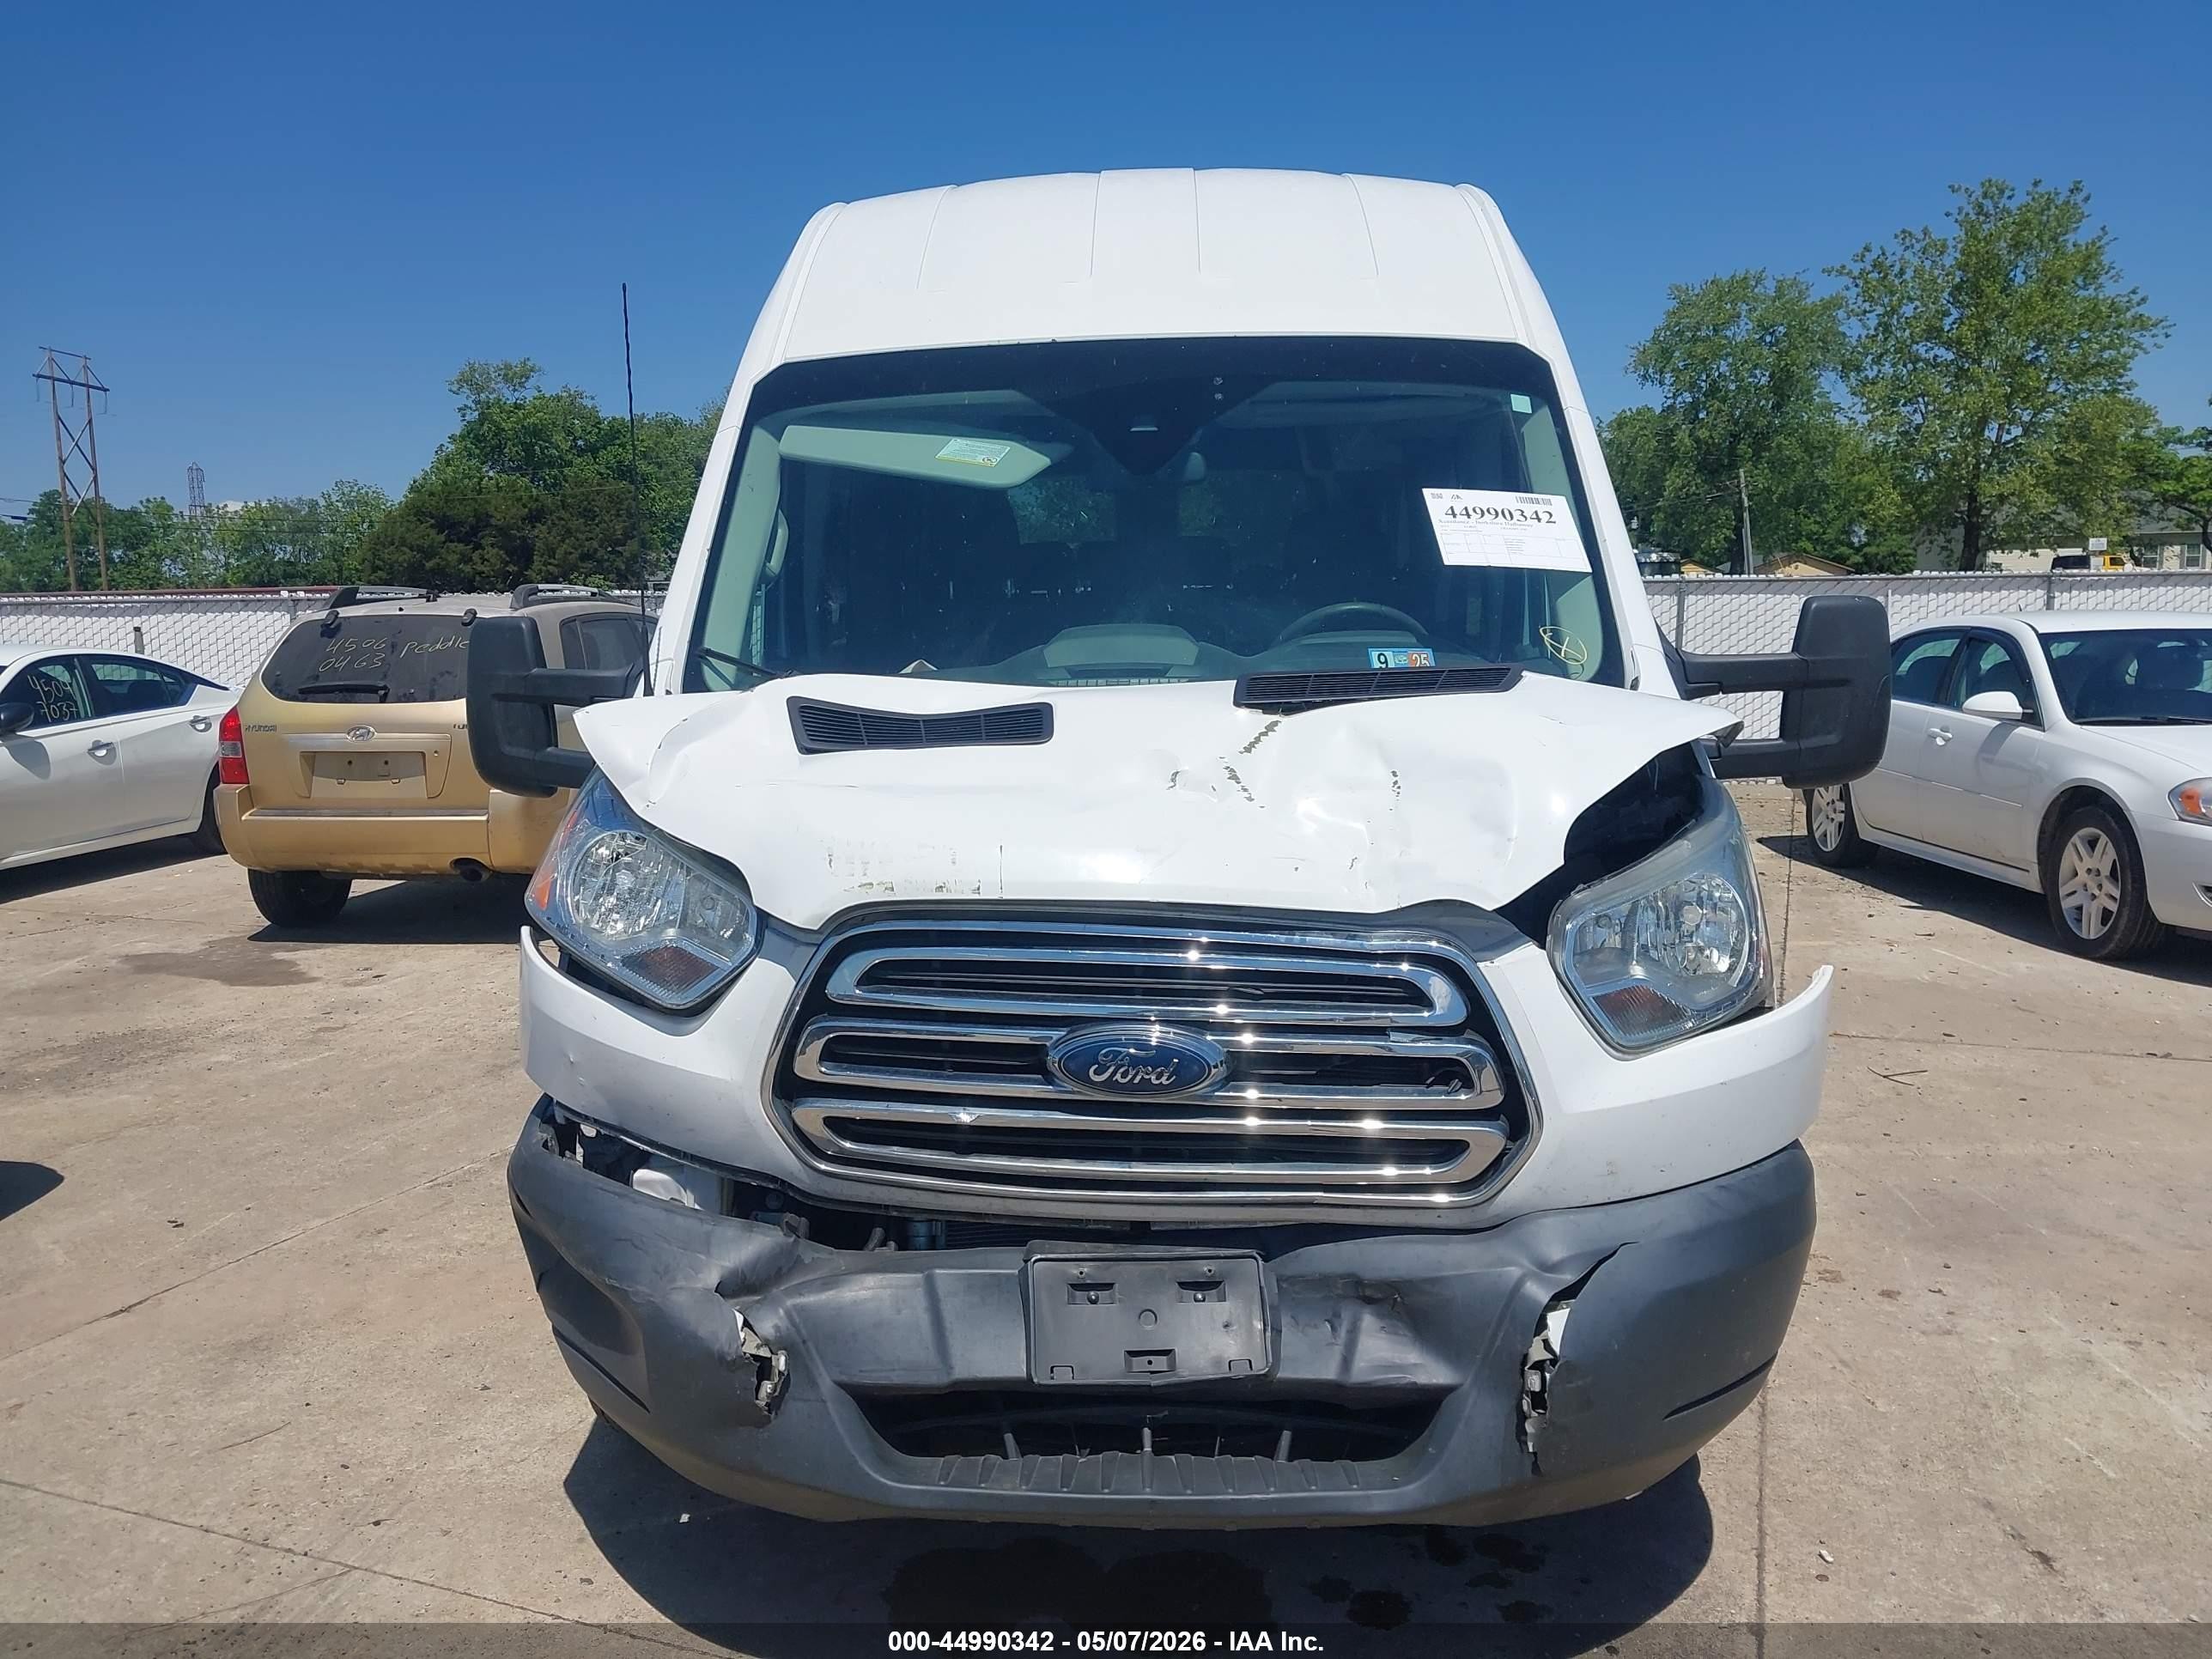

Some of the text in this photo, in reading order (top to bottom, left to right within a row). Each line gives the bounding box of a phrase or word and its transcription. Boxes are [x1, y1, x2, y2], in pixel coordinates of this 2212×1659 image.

[1444, 505, 1557, 525] 44990342
[325, 638, 387, 653] 4506
[319, 653, 386, 672] 0463
[1376, 653, 1389, 669] 9
[36, 701, 78, 723] 7037
[1088, 1047, 1181, 1085] Ford
